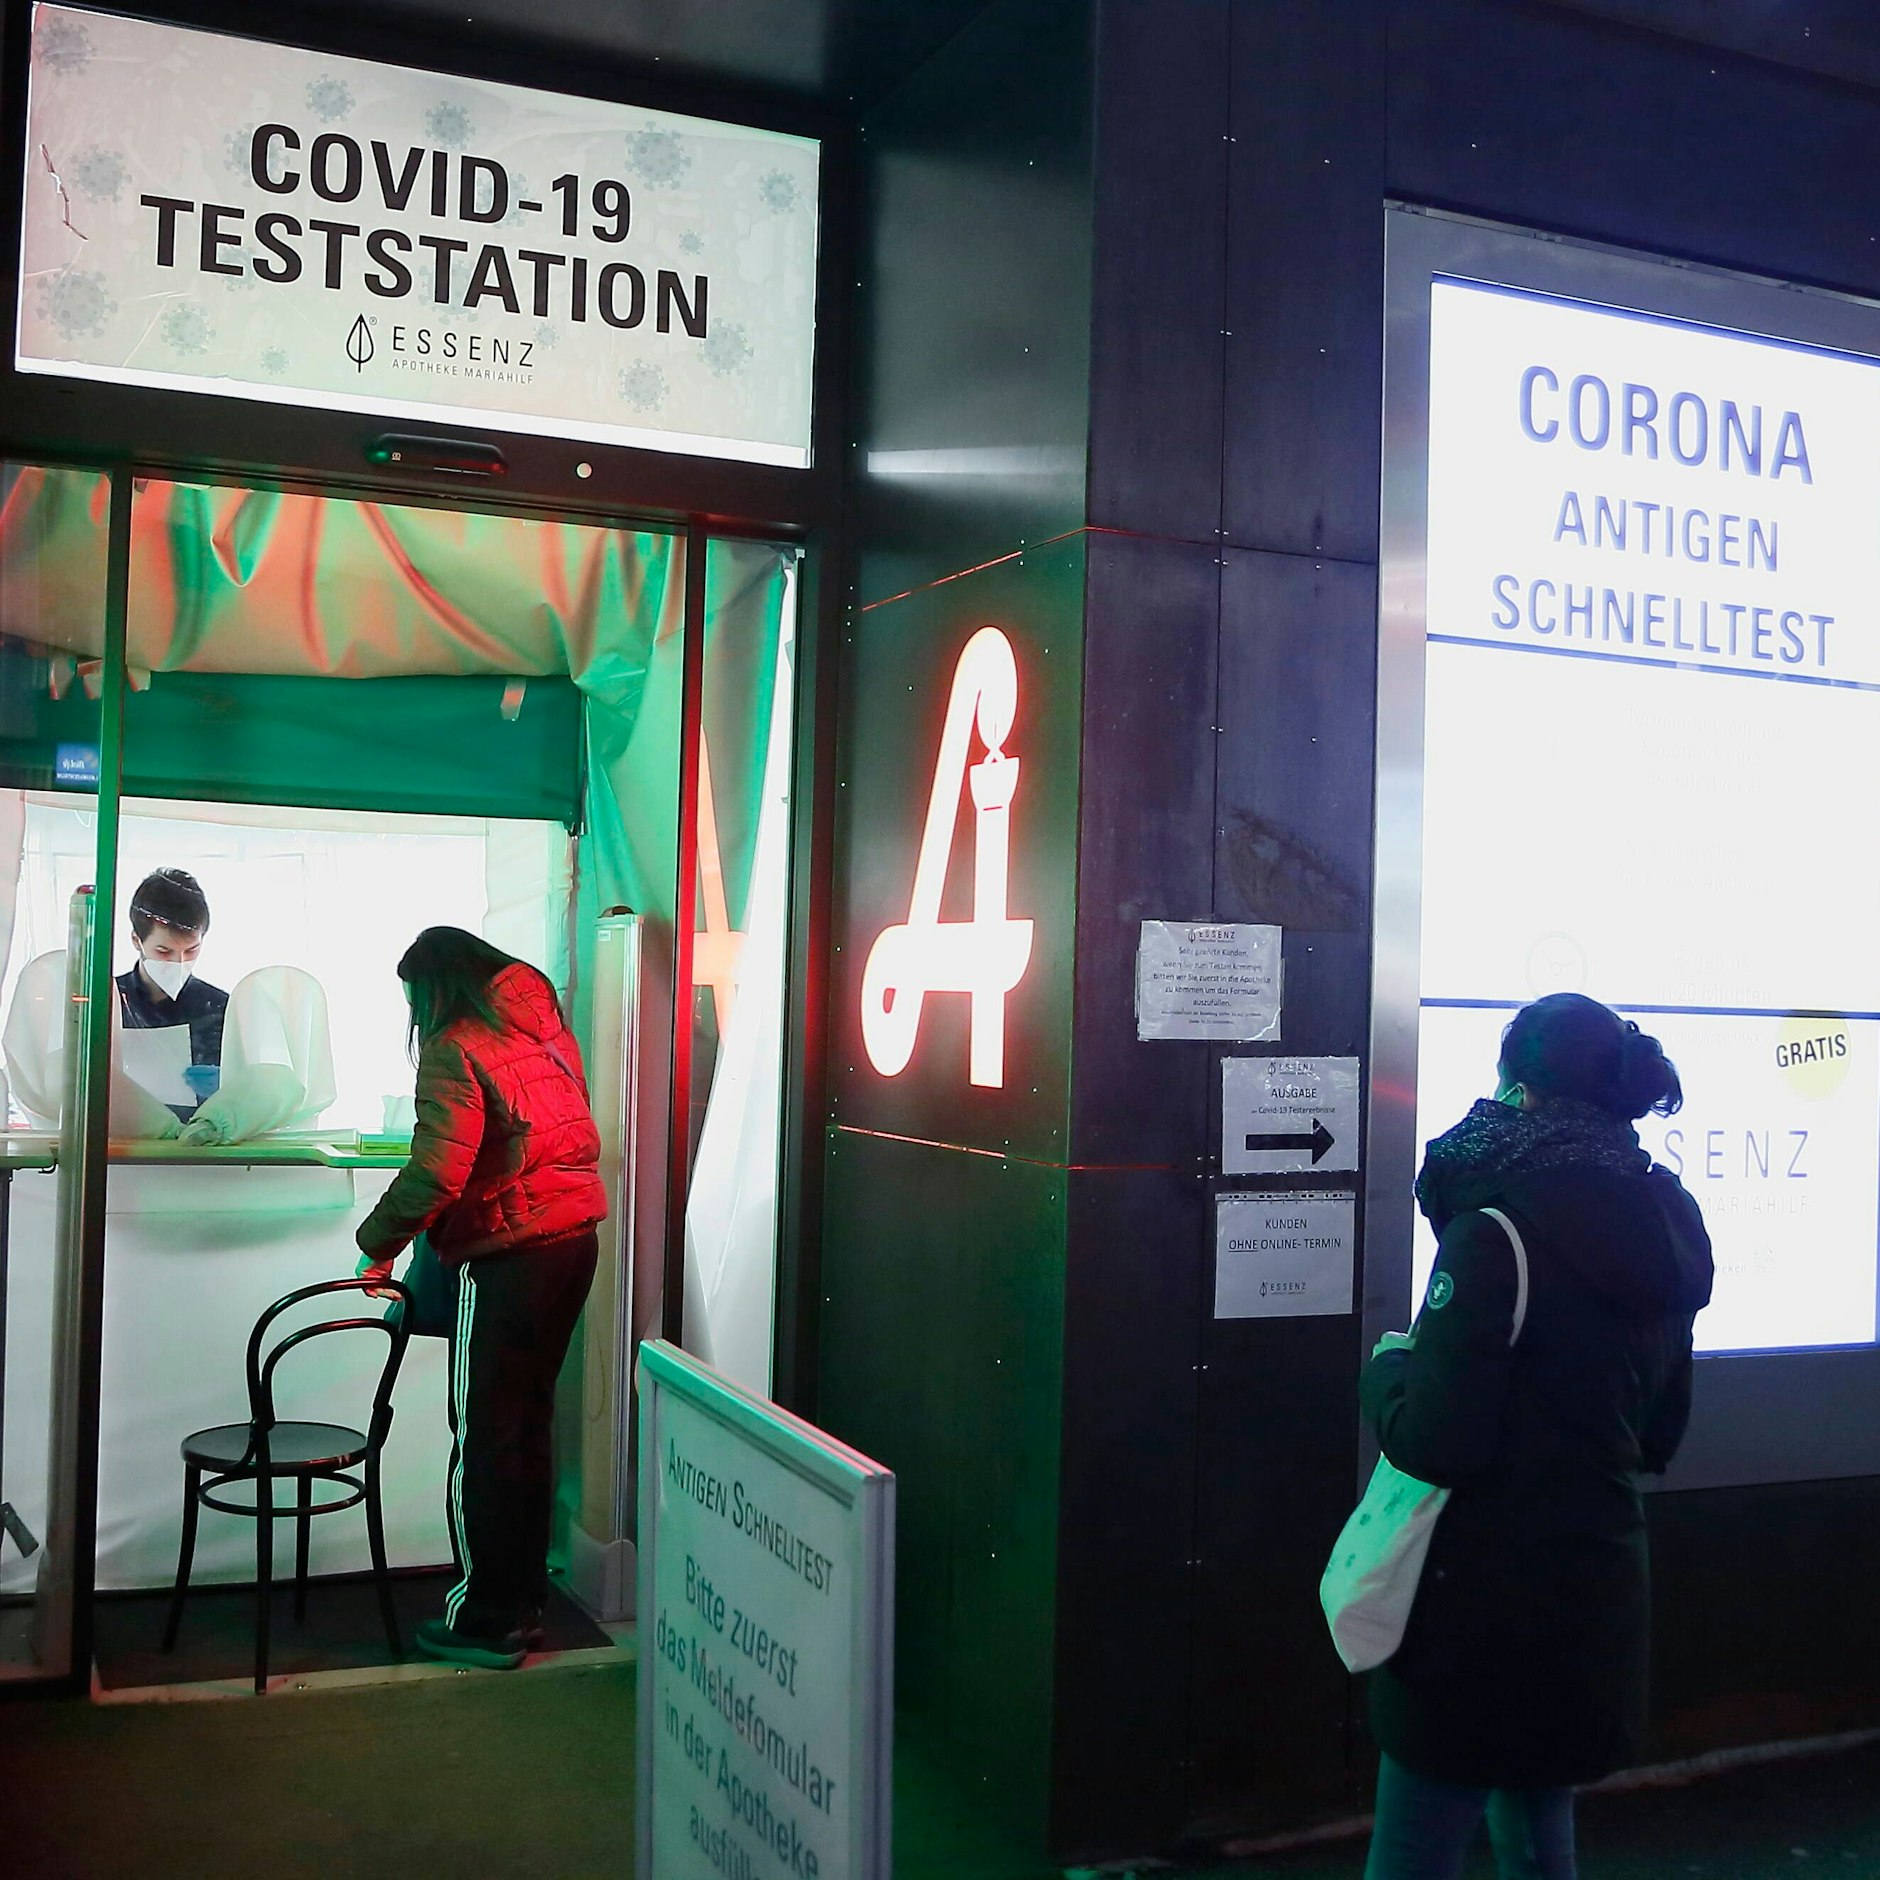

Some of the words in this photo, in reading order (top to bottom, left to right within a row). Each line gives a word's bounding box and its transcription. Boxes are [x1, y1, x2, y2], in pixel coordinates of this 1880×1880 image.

[250, 122, 632, 244] COVID-19
[139, 193, 710, 340] TESTSTATION
[391, 358, 459, 377] APOTHEKE
[463, 367, 534, 385] MARIAHILF
[392, 325, 534, 368] ESSENZ
[1518, 364, 1814, 486] CORONA
[1552, 491, 1779, 573] ANTIGEN
[1490, 573, 1836, 667] SCHNELLTEST
[1199, 930, 1235, 939] ESSENZ
[1775, 1033, 1847, 1068] GRATIS
[1258, 1105, 1288, 1114] Covid-19
[1288, 1106, 1336, 1116] Testergebnisse
[1271, 1087, 1317, 1099] AUSGABE
[1664, 1128, 1809, 1179] SENZ
[1228, 1239, 1258, 1251] OHNE
[1260, 1238, 1302, 1250] ONLINE-
[1303, 1237, 1342, 1249] TERMIN
[1265, 1218, 1308, 1230] KUNDEN
[1270, 1281, 1306, 1292] ESSENZ
[686, 1554, 726, 1634] Bitte
[730, 1609, 798, 1698] zuerst
[656, 1608, 687, 1674] das
[690, 1636, 836, 1816] Meldefomular
[665, 1686, 680, 1742] in
[684, 1713, 713, 1778] der
[717, 1748, 819, 1880] Apotheke
[690, 1804, 761, 1880] ausfüll
